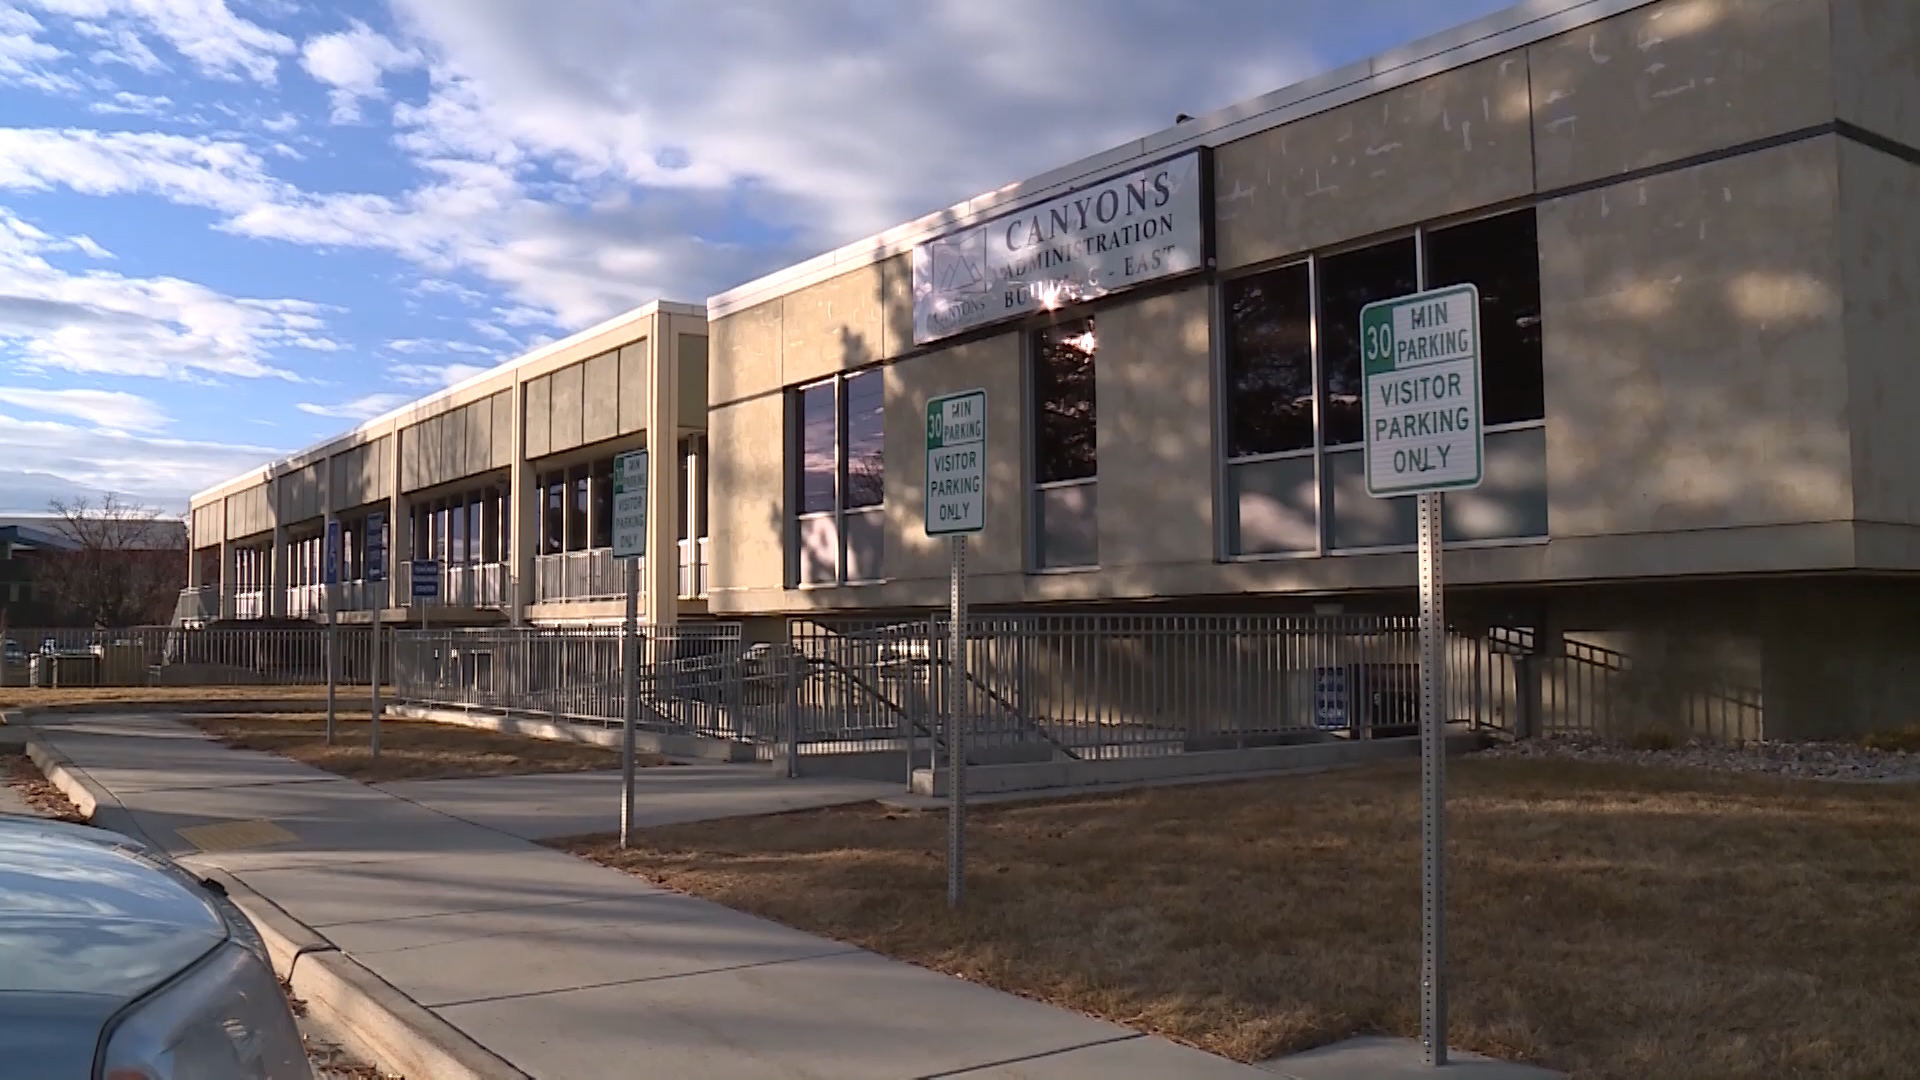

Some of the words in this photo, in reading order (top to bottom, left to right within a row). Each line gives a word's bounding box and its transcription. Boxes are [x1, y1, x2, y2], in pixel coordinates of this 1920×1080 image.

[1006, 171, 1170, 251] CANYONS
[1004, 213, 1173, 280] ADMINISTRATION
[1411, 301, 1448, 329] MIN
[1367, 323, 1391, 360] 30
[1398, 329, 1468, 363] PARKING
[1381, 373, 1461, 406] VISITOR
[952, 400, 971, 419] MIN
[929, 413, 942, 439] 30
[944, 420, 981, 441] PARKING
[1376, 407, 1469, 441] PARKING
[934, 451, 977, 472] VISITOR
[1394, 444, 1451, 473] ONLY
[931, 475, 979, 497] PARKING
[939, 502, 970, 521] ONLY
